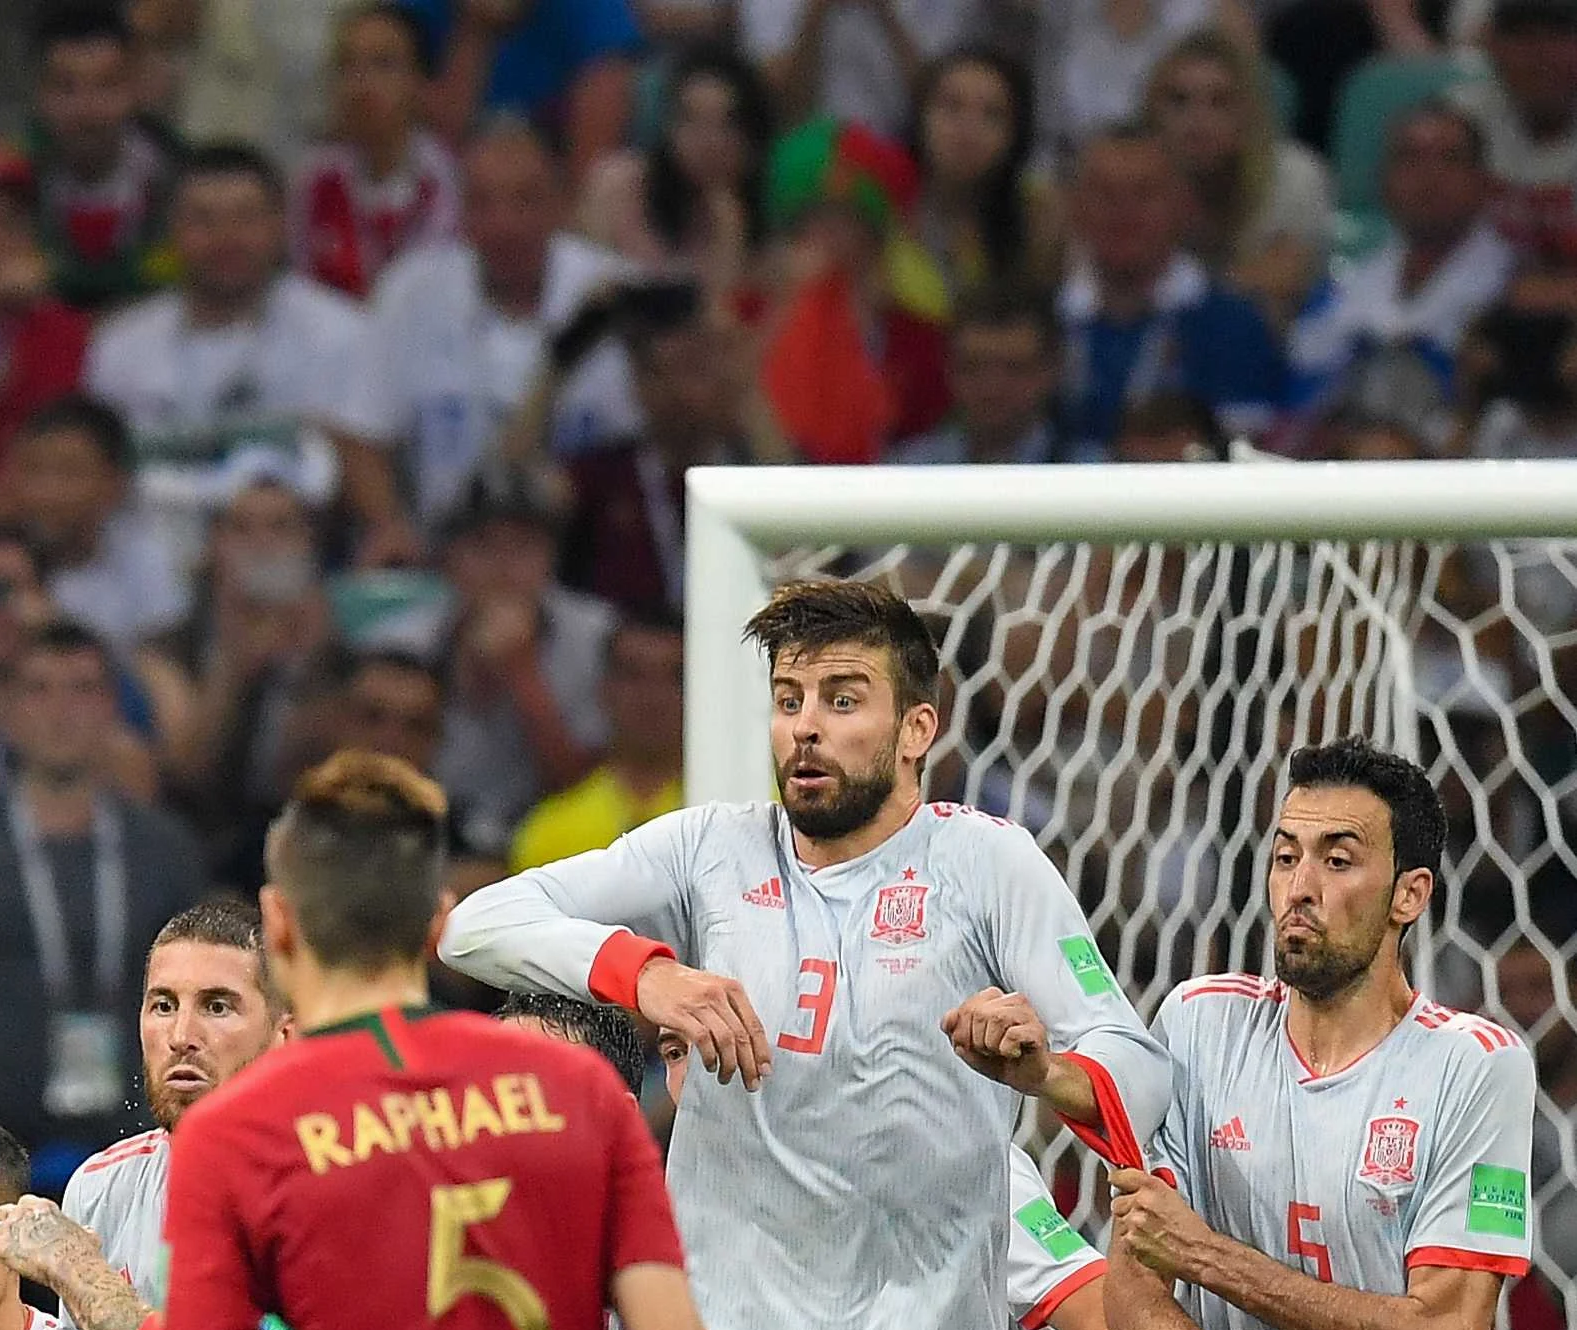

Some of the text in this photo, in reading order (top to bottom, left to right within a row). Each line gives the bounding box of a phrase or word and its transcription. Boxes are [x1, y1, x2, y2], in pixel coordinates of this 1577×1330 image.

[777, 957, 838, 1056] 3
[294, 1072, 567, 1176] RAPHAEL
[1288, 1200, 1334, 1284] 5
